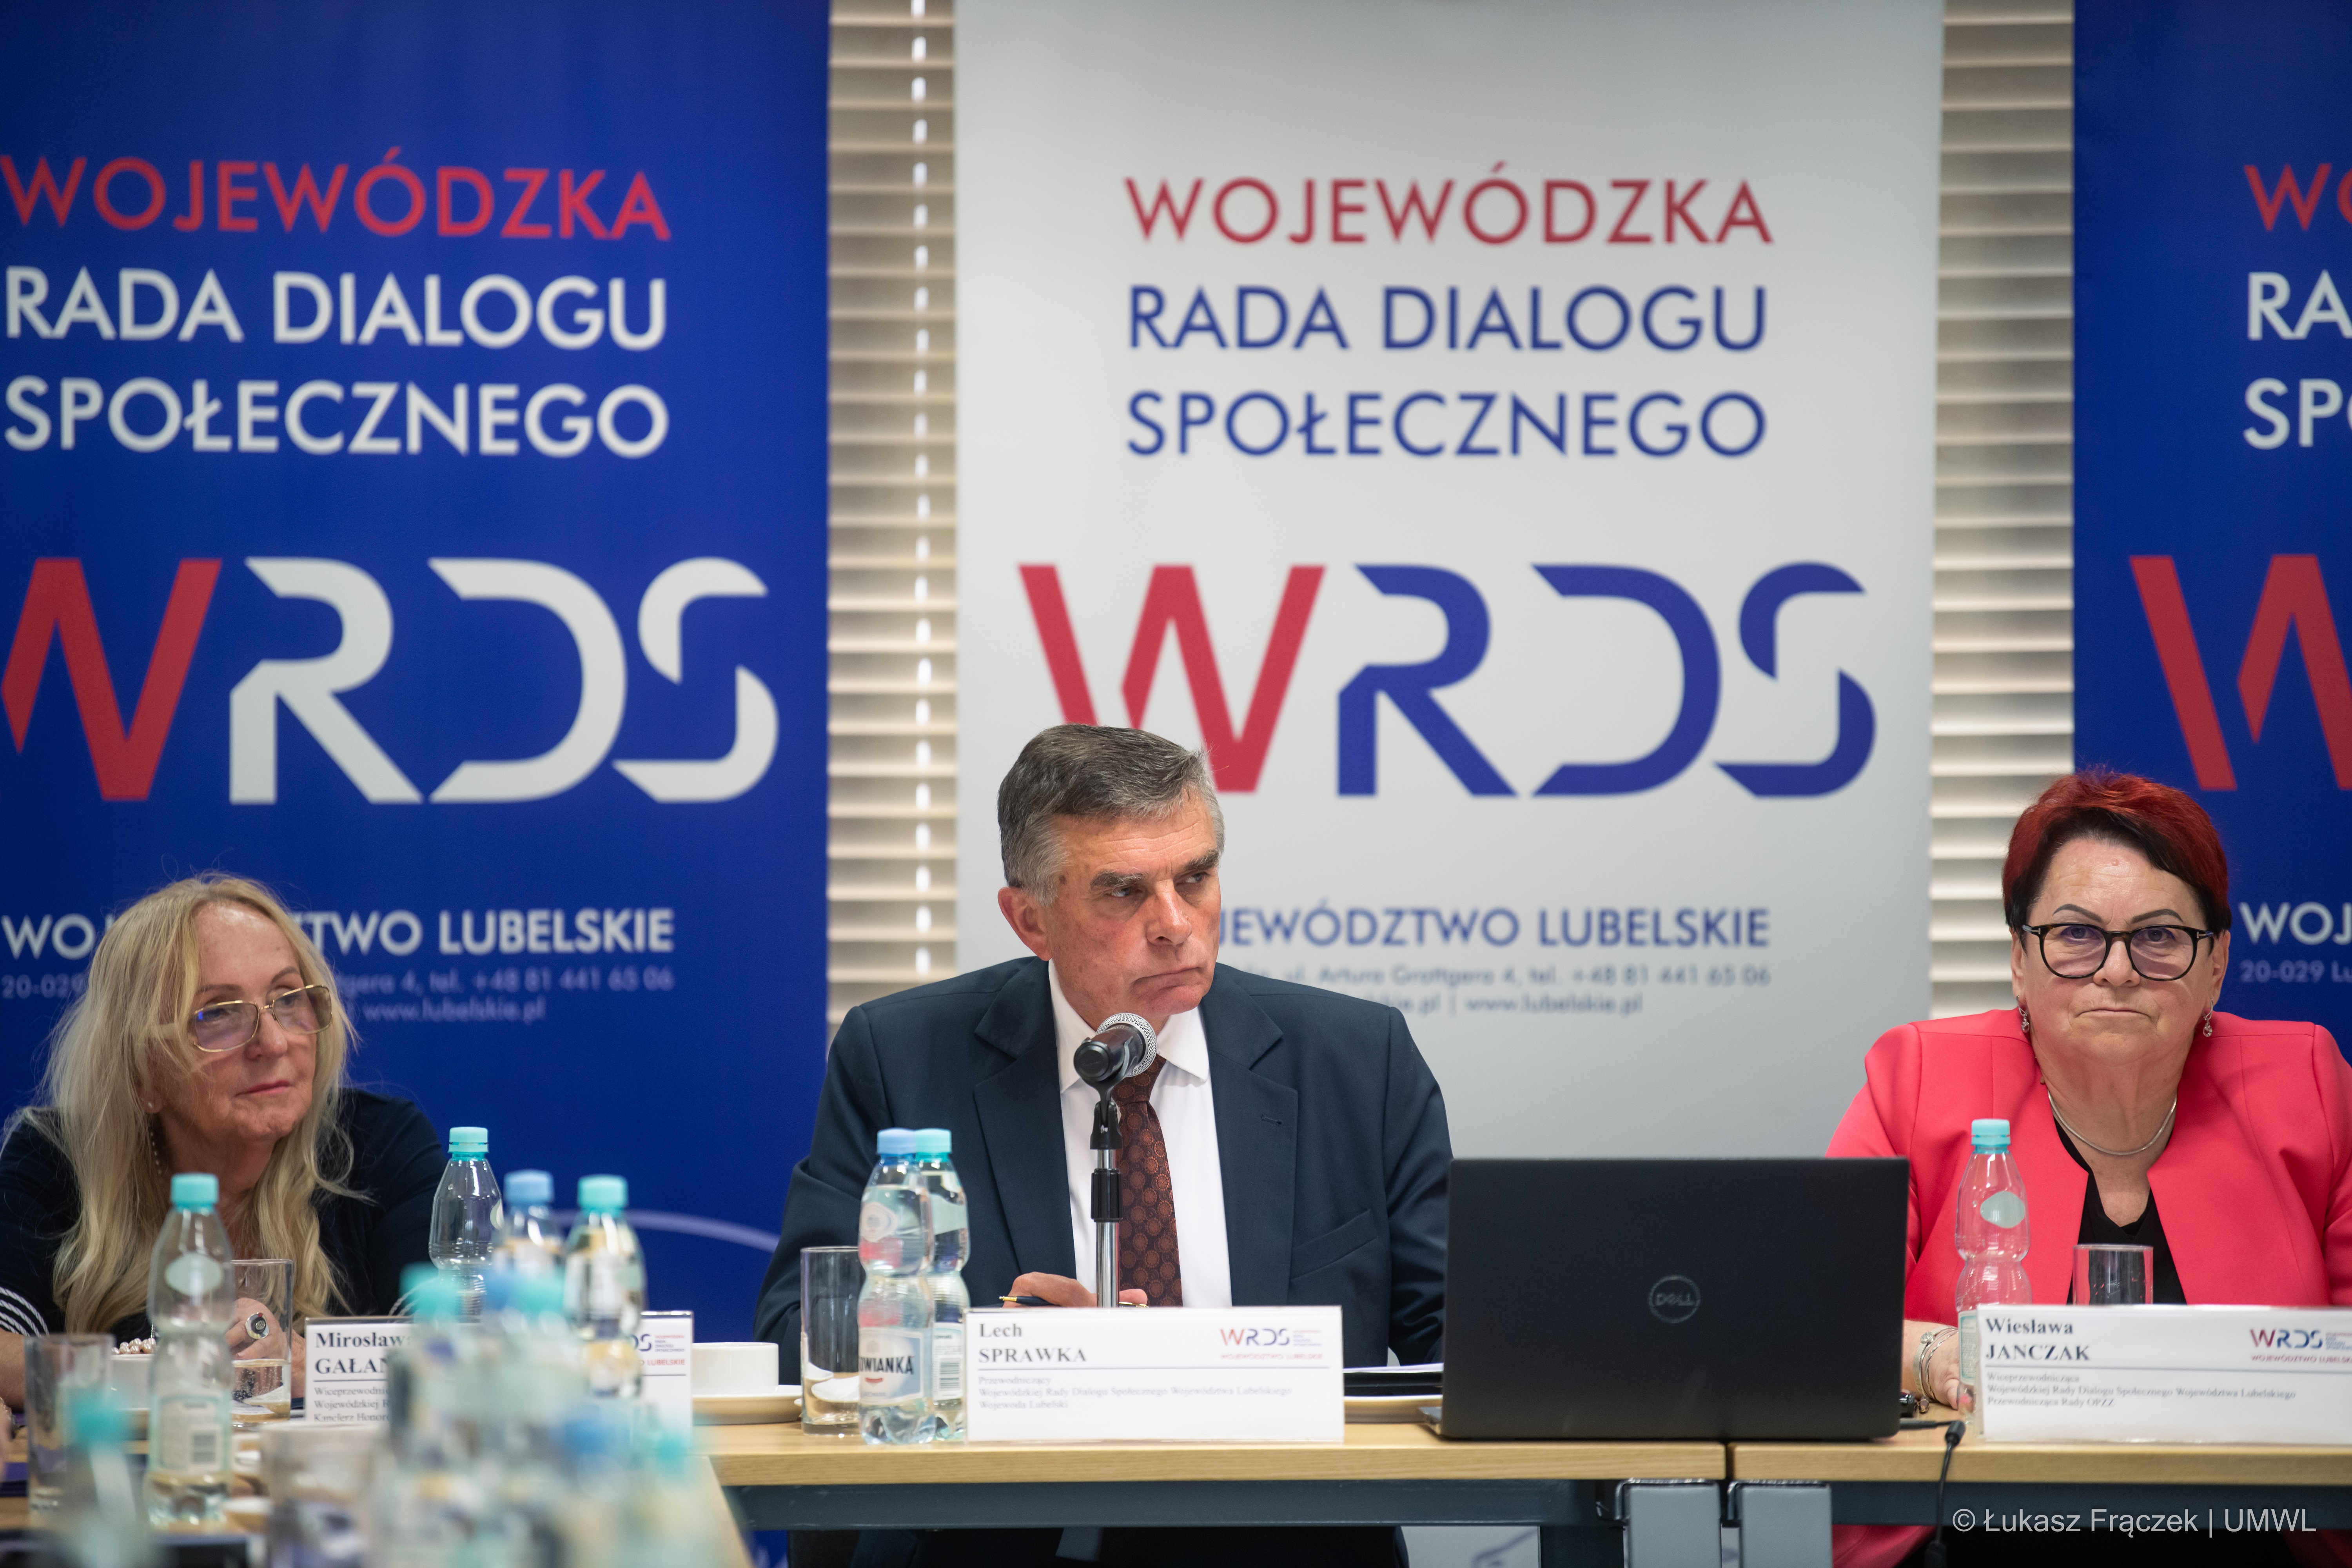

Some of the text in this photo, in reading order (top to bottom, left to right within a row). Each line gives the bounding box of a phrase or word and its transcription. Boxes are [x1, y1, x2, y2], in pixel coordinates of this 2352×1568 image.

[0, 147, 671, 240] WOJEWÓDZKA
[1125, 161, 1773, 245] WOJEWÓDZKA
[5, 266, 666, 350] RADA DIALOGU
[1129, 285, 1766, 352] RADA DIALOGU
[4, 375, 669, 459] SPOŁECZNEGO
[1127, 391, 1766, 457] SPOŁECZNEGO
[2243, 377, 2352, 449] SP
[1, 557, 779, 805] WRDS
[1018, 562, 1876, 799] WRDS
[439, 907, 675, 955] LUBELSKIE
[1539, 908, 1769, 947] LUBELSKIE
[2239, 960, 2325, 983] 20-029
[1656, 1293, 1694, 1306] DELL
[979, 1323, 1022, 1337] Lech
[1220, 1328, 1289, 1346] WRDS
[1986, 1318, 2074, 1334] Wiesława
[2250, 1328, 2323, 1348] WRDS
[979, 1348, 1087, 1363] SPRAWKA
[1985, 1345, 2090, 1360] JANCZAK
[1045, 1388, 1069, 1398] Rady
[1072, 1388, 1109, 1398] Dialogu
[2053, 1386, 2075, 1396] Rady
[2079, 1386, 2114, 1396] Dialogu
[2061, 1397, 2084, 1408] Rady
